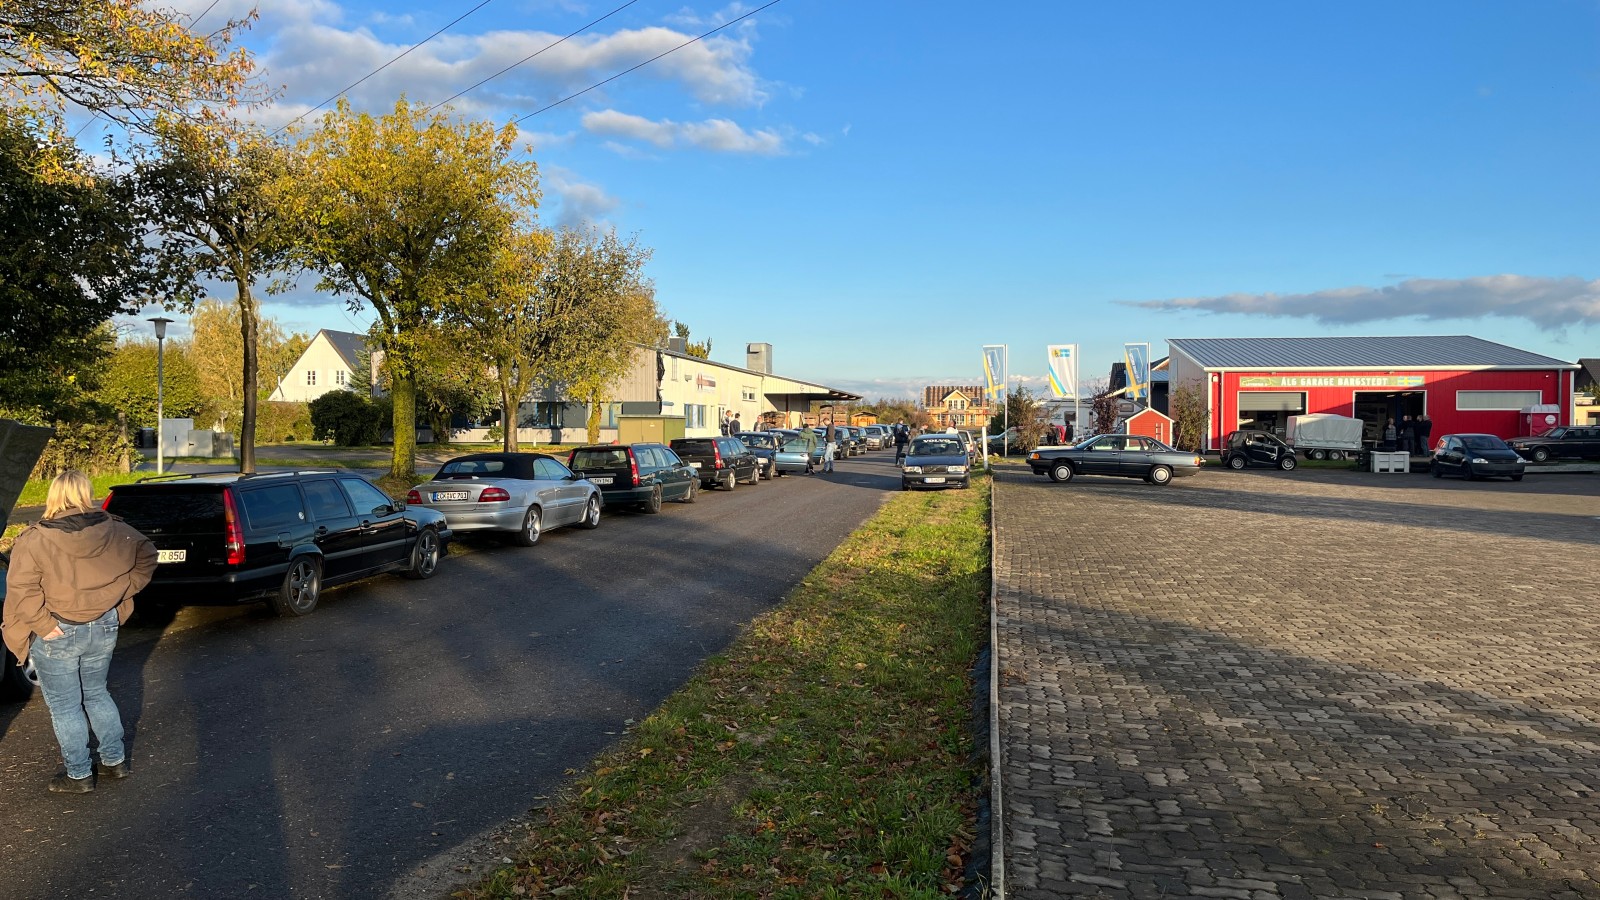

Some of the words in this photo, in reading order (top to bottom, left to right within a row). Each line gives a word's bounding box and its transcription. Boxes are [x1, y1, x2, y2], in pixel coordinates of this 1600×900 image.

[1300, 378, 1334, 386] GARAGE
[1337, 377, 1388, 386] BARGSTEDT
[168, 551, 184, 560] 850
